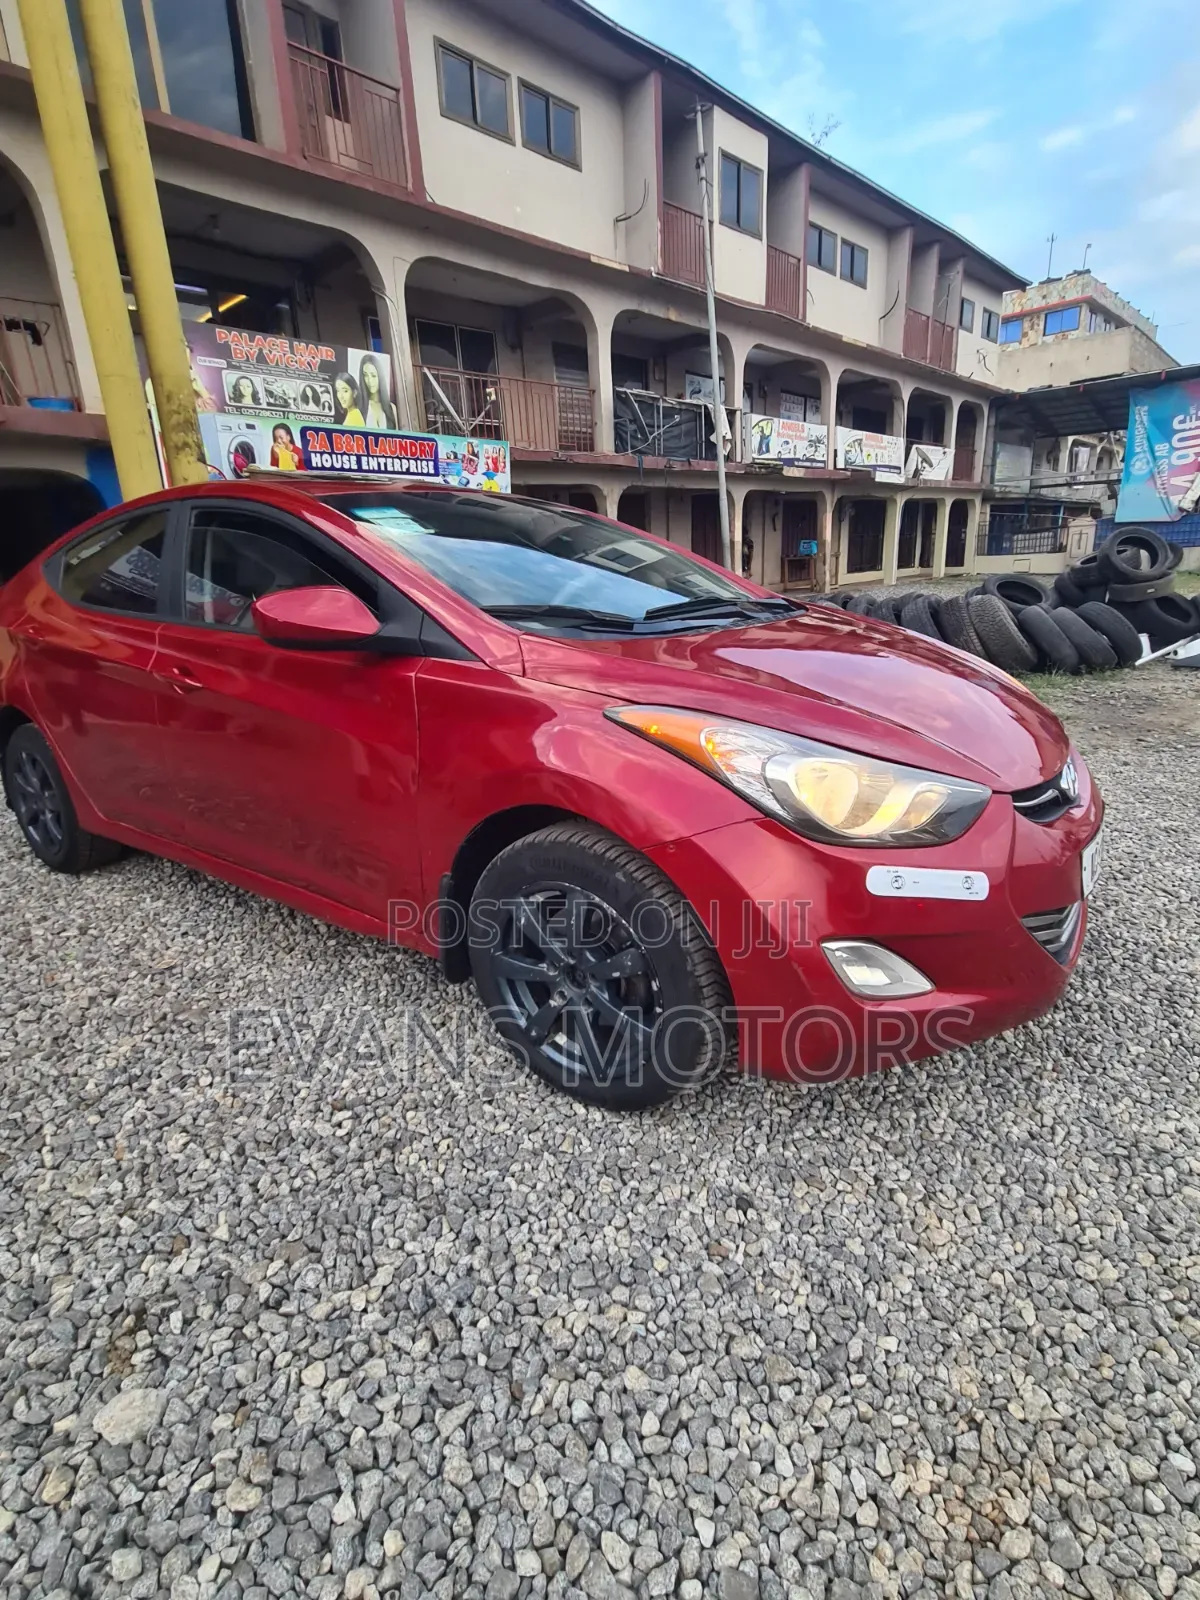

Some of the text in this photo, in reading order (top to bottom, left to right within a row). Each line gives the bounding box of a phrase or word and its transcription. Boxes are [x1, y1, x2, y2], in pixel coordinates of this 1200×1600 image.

[215, 328, 336, 362] PALACE HAIR
[231, 345, 258, 365] BY
[263, 350, 321, 373] VICKY
[307, 430, 437, 460] 2A B&R LAUNDRY
[310, 452, 358, 470] HOUSE
[361, 456, 435, 475] ENTERPRISE
